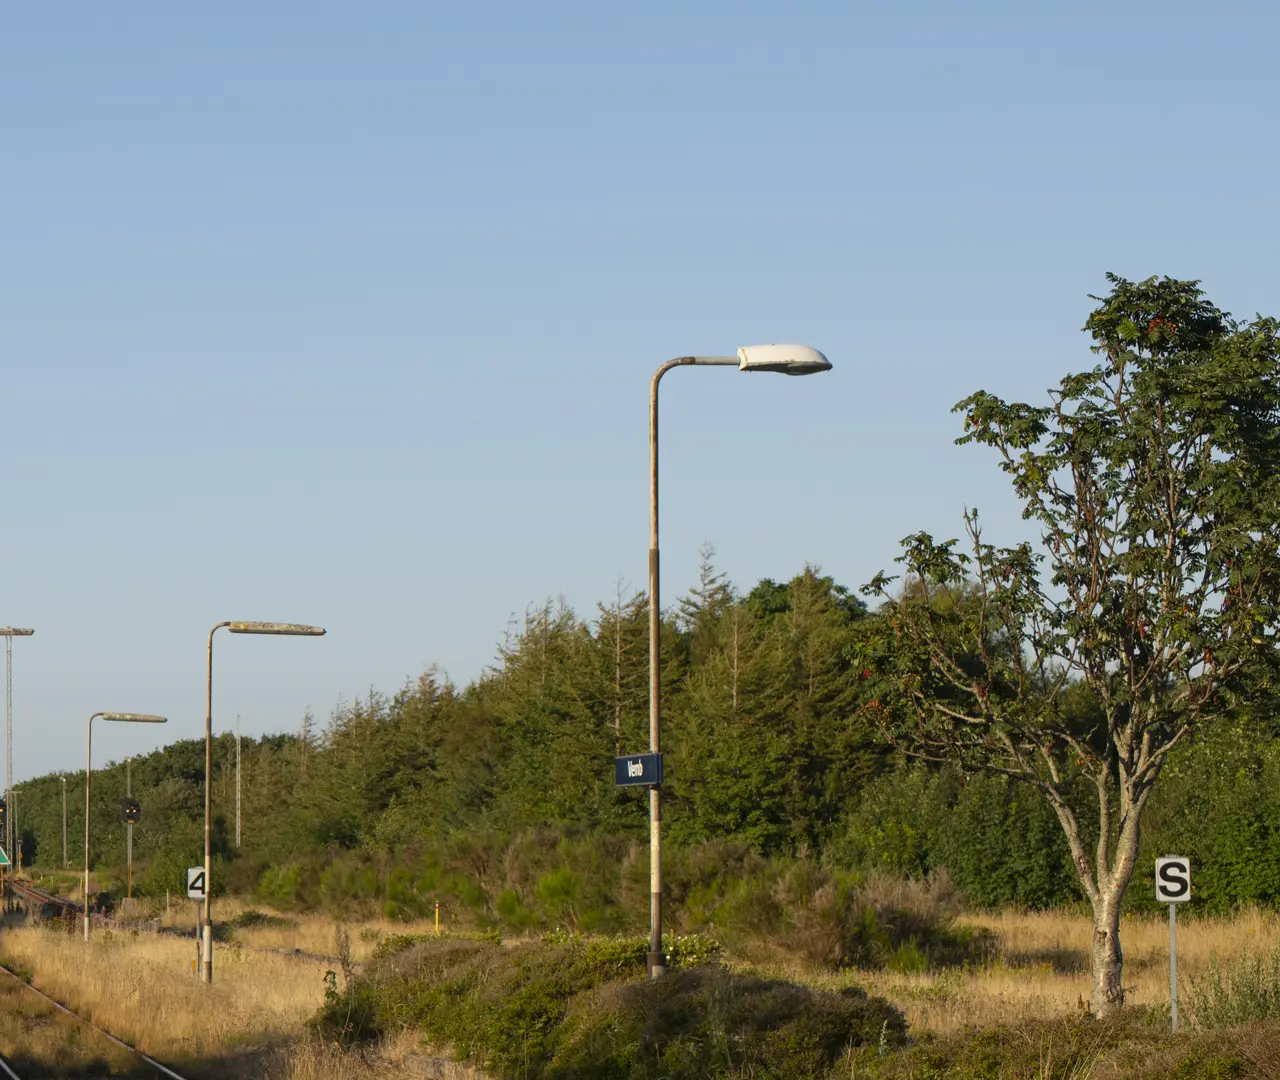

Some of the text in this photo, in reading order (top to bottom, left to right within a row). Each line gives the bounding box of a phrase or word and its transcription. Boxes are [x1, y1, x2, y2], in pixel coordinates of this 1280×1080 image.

[627, 758, 644, 778] Vemb
[189, 871, 206, 895] 4
[1158, 861, 1189, 898] S
